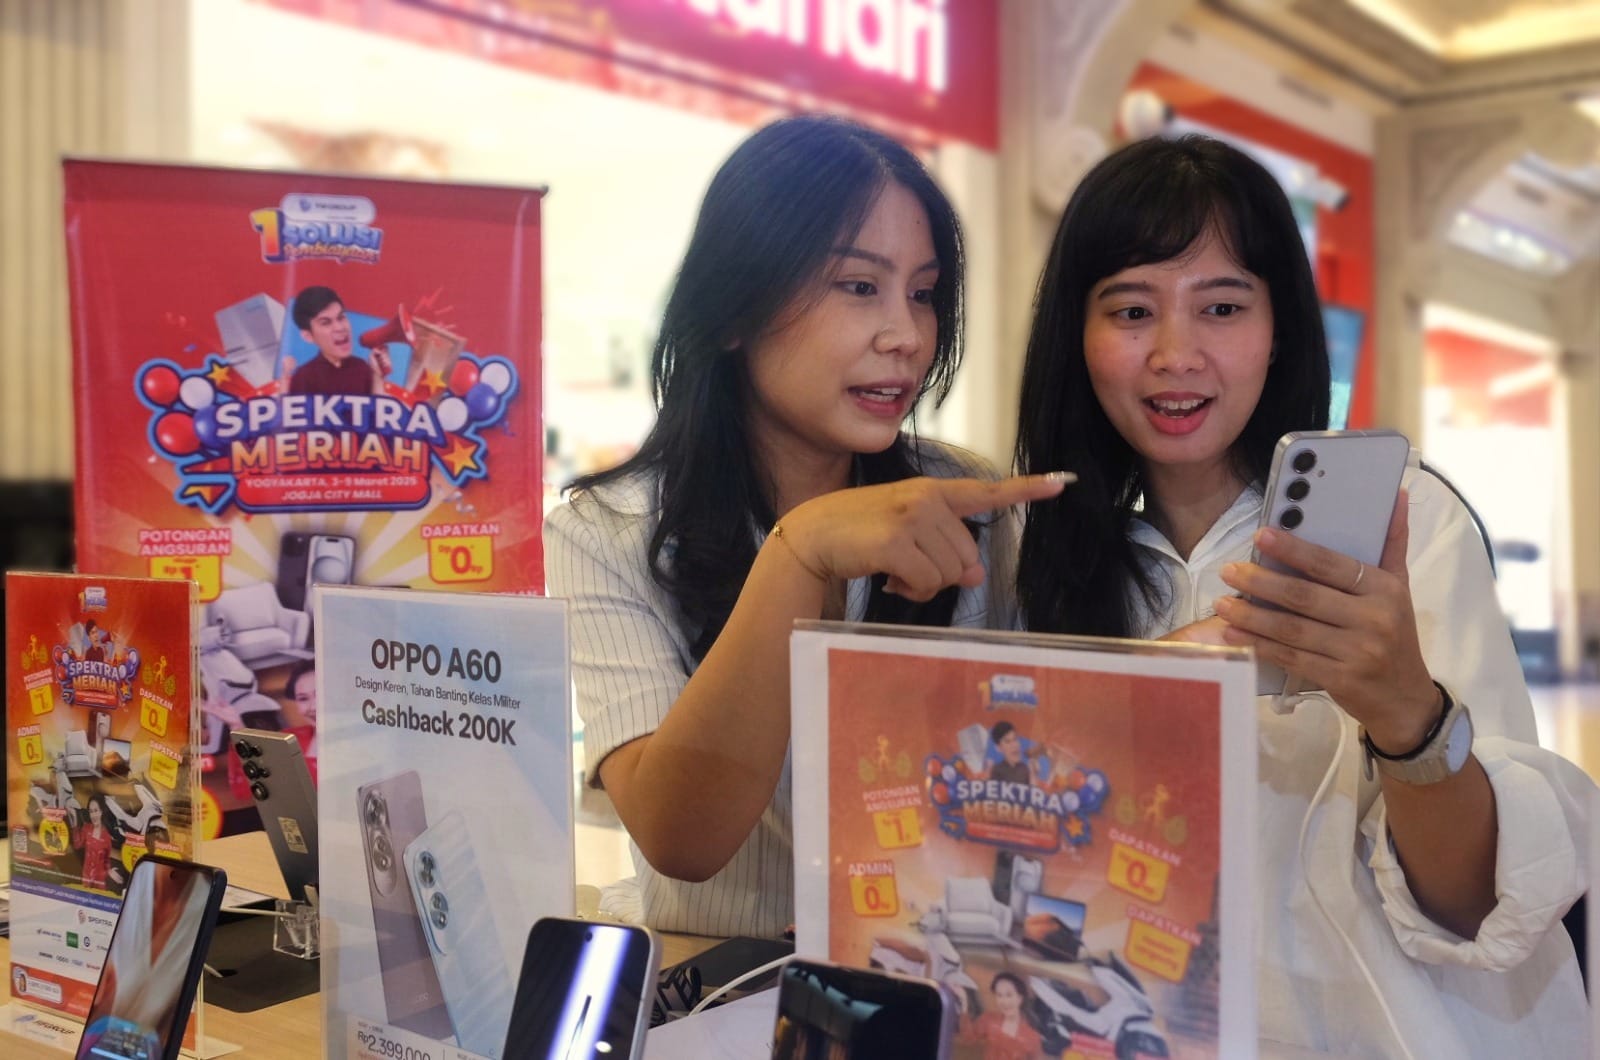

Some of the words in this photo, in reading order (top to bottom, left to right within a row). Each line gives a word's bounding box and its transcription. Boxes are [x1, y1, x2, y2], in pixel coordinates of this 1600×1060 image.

[250, 209, 284, 262] 1
[283, 223, 381, 250] SOLUSI
[215, 394, 438, 438] SPEKTRA
[231, 431, 422, 473] MERIAH
[245, 477, 326, 489] YOGYAKARTA,
[354, 476, 389, 486] Maret
[282, 490, 323, 501] JOGJA
[324, 489, 350, 500] CITY
[352, 489, 382, 499] MALL
[139, 529, 229, 542] POTONGAN
[421, 524, 500, 538] DAPATKAN
[141, 543, 229, 555] ANGSURAN
[69, 660, 119, 681] SPEKTRA
[371, 638, 442, 677] OPPO
[446, 647, 502, 684] A60
[72, 675, 116, 693] MERIAH
[355, 676, 383, 692] Design
[383, 679, 409, 696] Keren,
[410, 683, 435, 698] Tahan
[436, 686, 468, 706] Banting
[468, 691, 493, 707] Kelas
[493, 694, 521, 710] Militer
[140, 687, 173, 711] DAPATKAN
[362, 699, 454, 736] Cashback
[458, 712, 517, 746] 200K
[150, 740, 183, 764] DAPATKAN
[863, 784, 920, 802] POTONGAN
[956, 780, 1064, 815] SPEKTRA
[963, 801, 1057, 833] MERIAH
[1108, 828, 1182, 867] DAPATKAN
[848, 863, 894, 876] ADMIN
[1127, 905, 1203, 946] DAPATKAN
